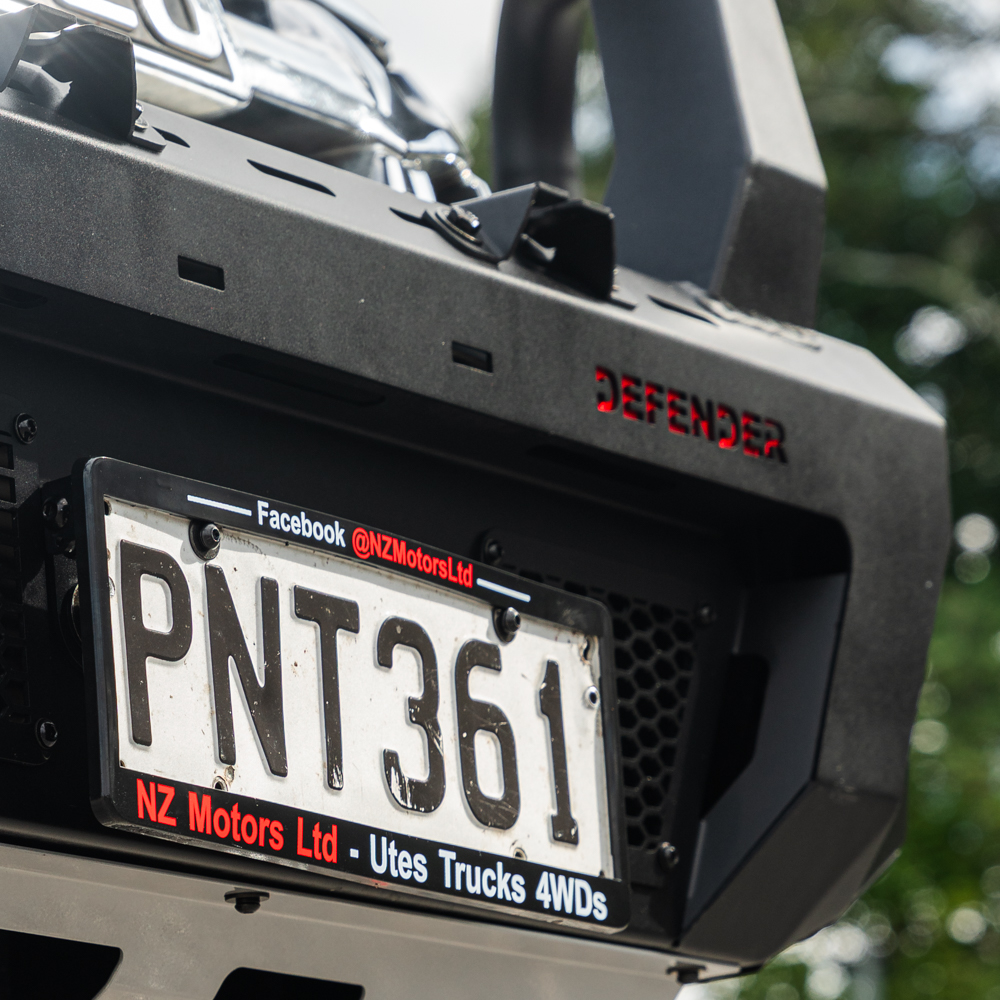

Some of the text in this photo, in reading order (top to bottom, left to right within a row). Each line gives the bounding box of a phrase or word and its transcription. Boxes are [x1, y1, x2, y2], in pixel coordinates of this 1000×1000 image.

[596, 365, 788, 464] DEFENDER
[257, 500, 474, 589] Facebook @NZMotorsLtd
[119, 538, 580, 846] PNT361
[136, 778, 177, 826] NZ
[188, 791, 285, 851] Motors
[296, 816, 338, 863] Ltd
[369, 833, 428, 883] Utes
[438, 849, 526, 904] Trucks
[535, 870, 608, 921] 4WDs
